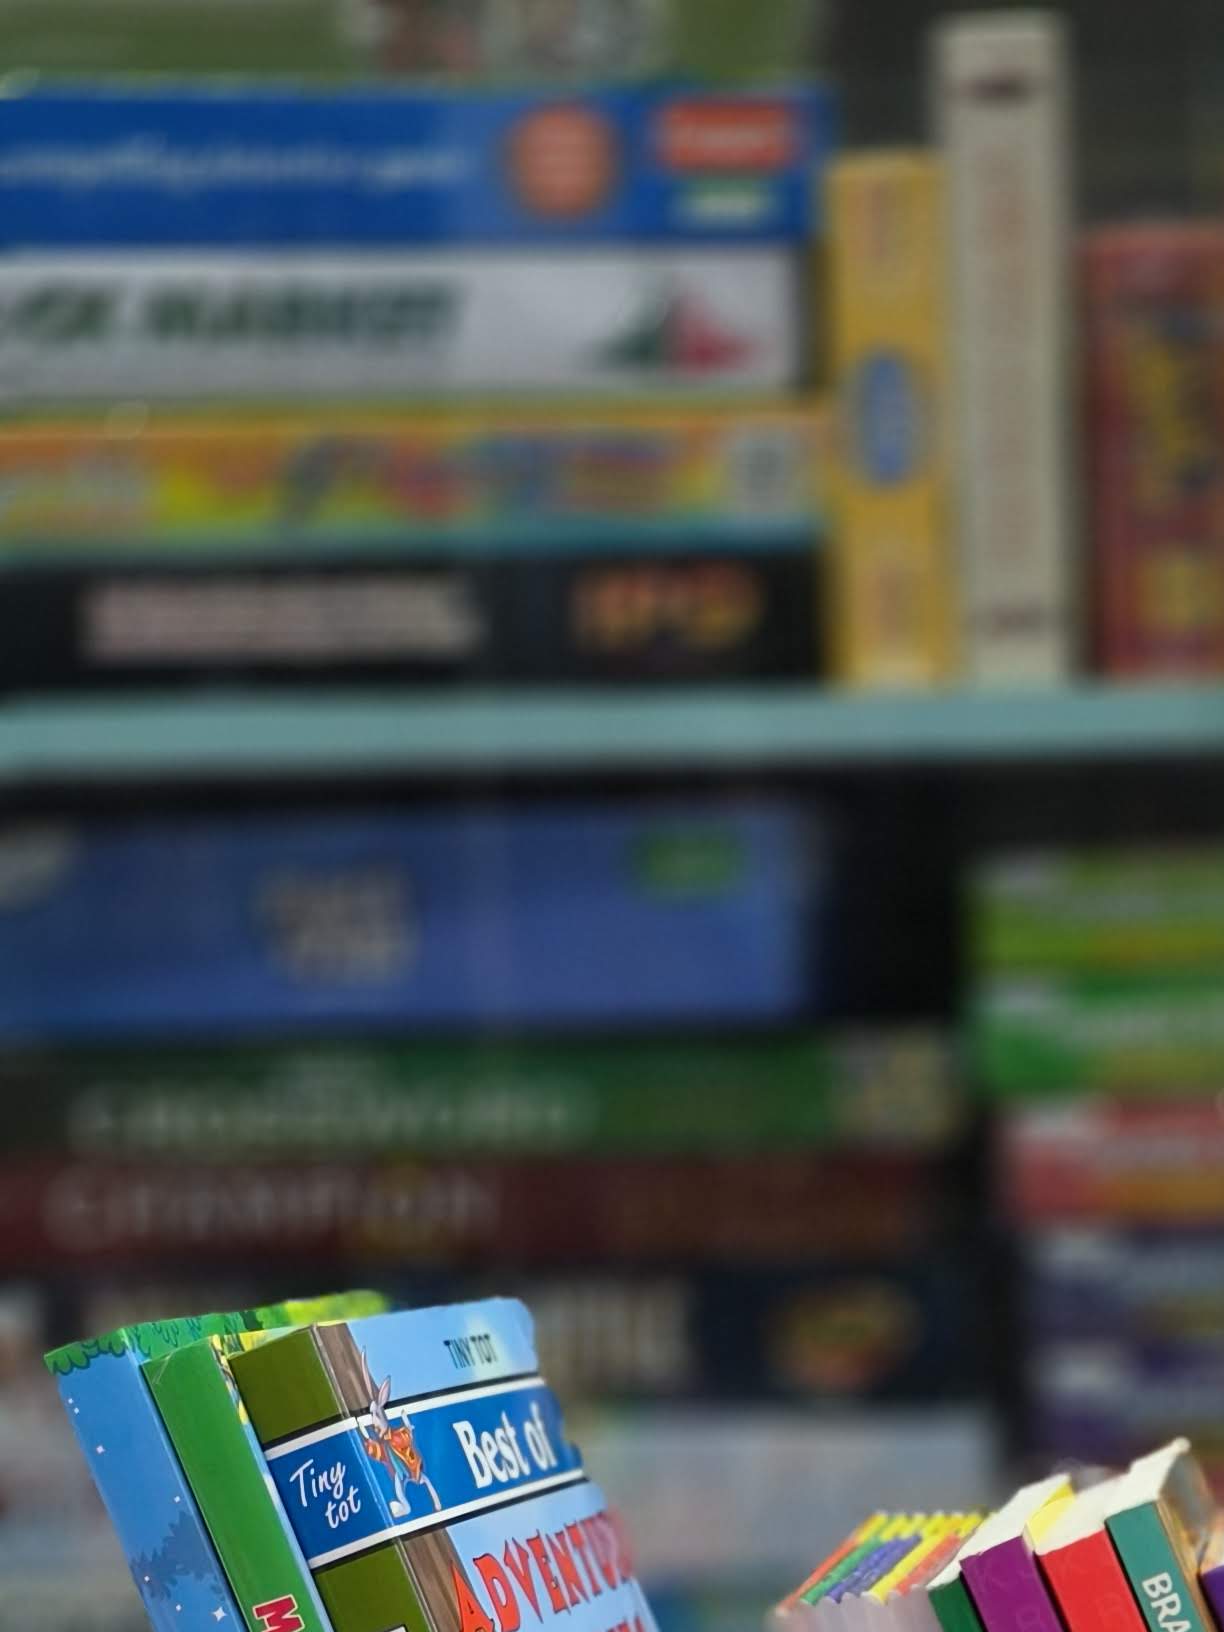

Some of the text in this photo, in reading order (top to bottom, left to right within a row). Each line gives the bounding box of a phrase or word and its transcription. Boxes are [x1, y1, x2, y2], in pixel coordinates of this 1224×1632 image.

[443, 1334, 498, 1369] TINY TOT
[452, 1402, 558, 1488] Best of
[289, 1458, 346, 1509] Tiny
[324, 1495, 361, 1529] tot
